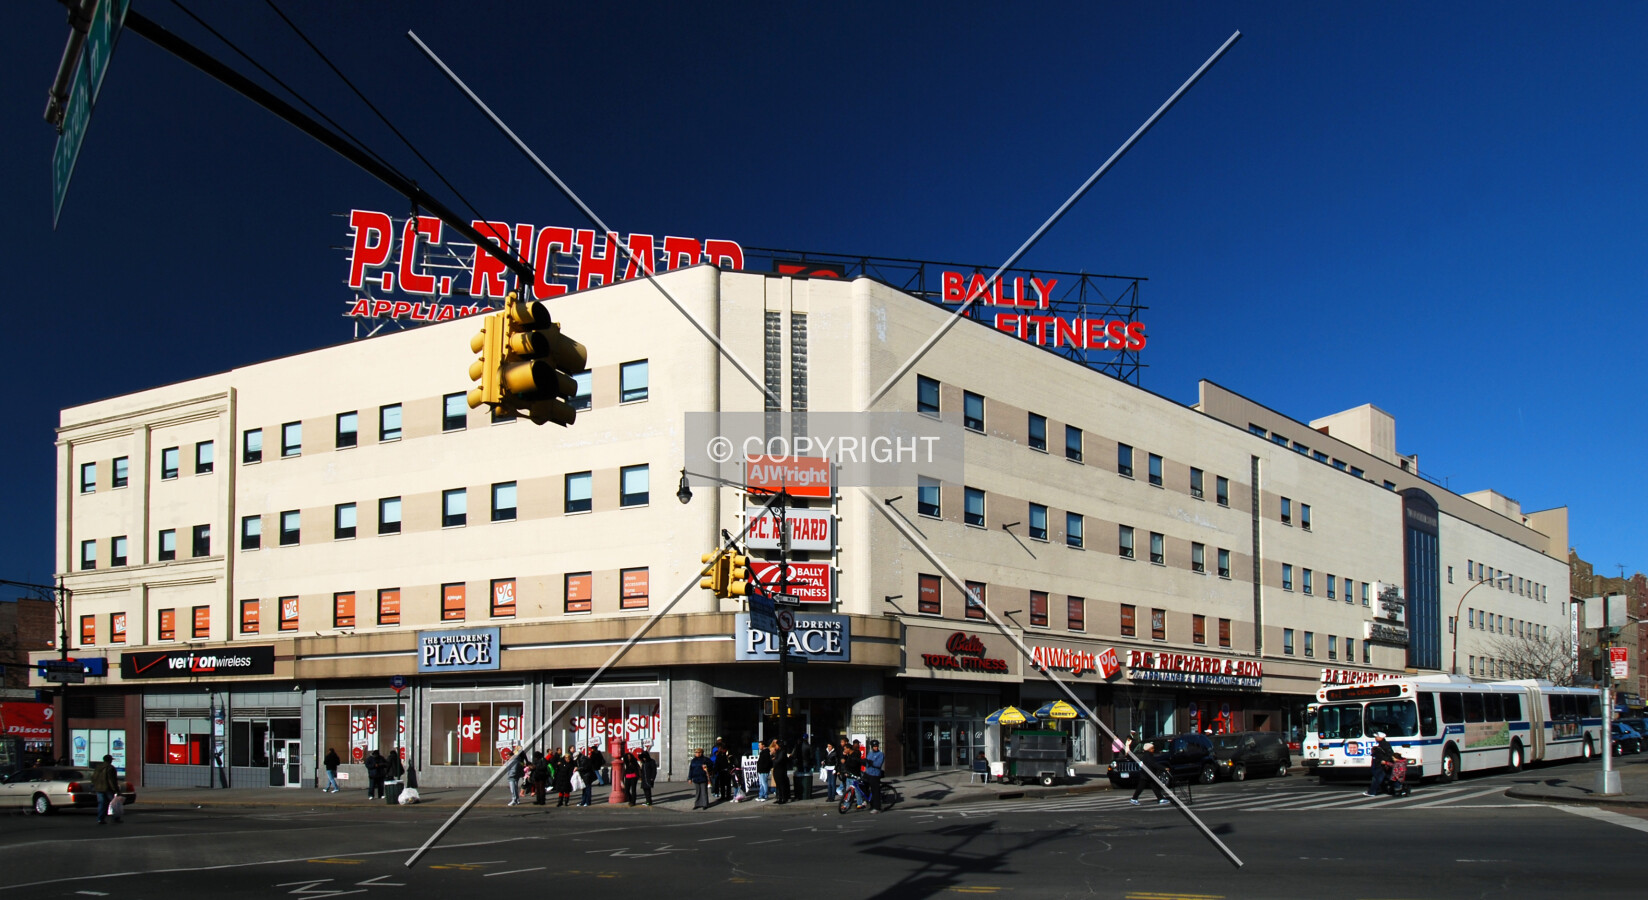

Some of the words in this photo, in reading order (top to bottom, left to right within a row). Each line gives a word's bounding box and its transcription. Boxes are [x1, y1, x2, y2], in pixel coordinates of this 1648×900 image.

[350, 210, 452, 297] P.C.
[941, 272, 1057, 310] BALLY
[995, 312, 1148, 352] FITNESS
[750, 463, 828, 487] AJWright
[795, 577, 825, 588] TOTAL
[796, 567, 825, 577] BALLY
[791, 587, 828, 598] FITNESS
[422, 635, 440, 645] THE
[440, 633, 490, 644] CHILDREN'S
[746, 629, 841, 653] PLACE
[168, 653, 217, 673] verizon
[216, 656, 252, 668] wireless
[422, 642, 490, 667] PLACE
[921, 653, 959, 668] TOTAL
[961, 656, 1008, 670] FITNESS
[1030, 646, 1094, 674] AJWright
[1158, 652, 1221, 675] RICHARD
[1235, 660, 1262, 677] SON
